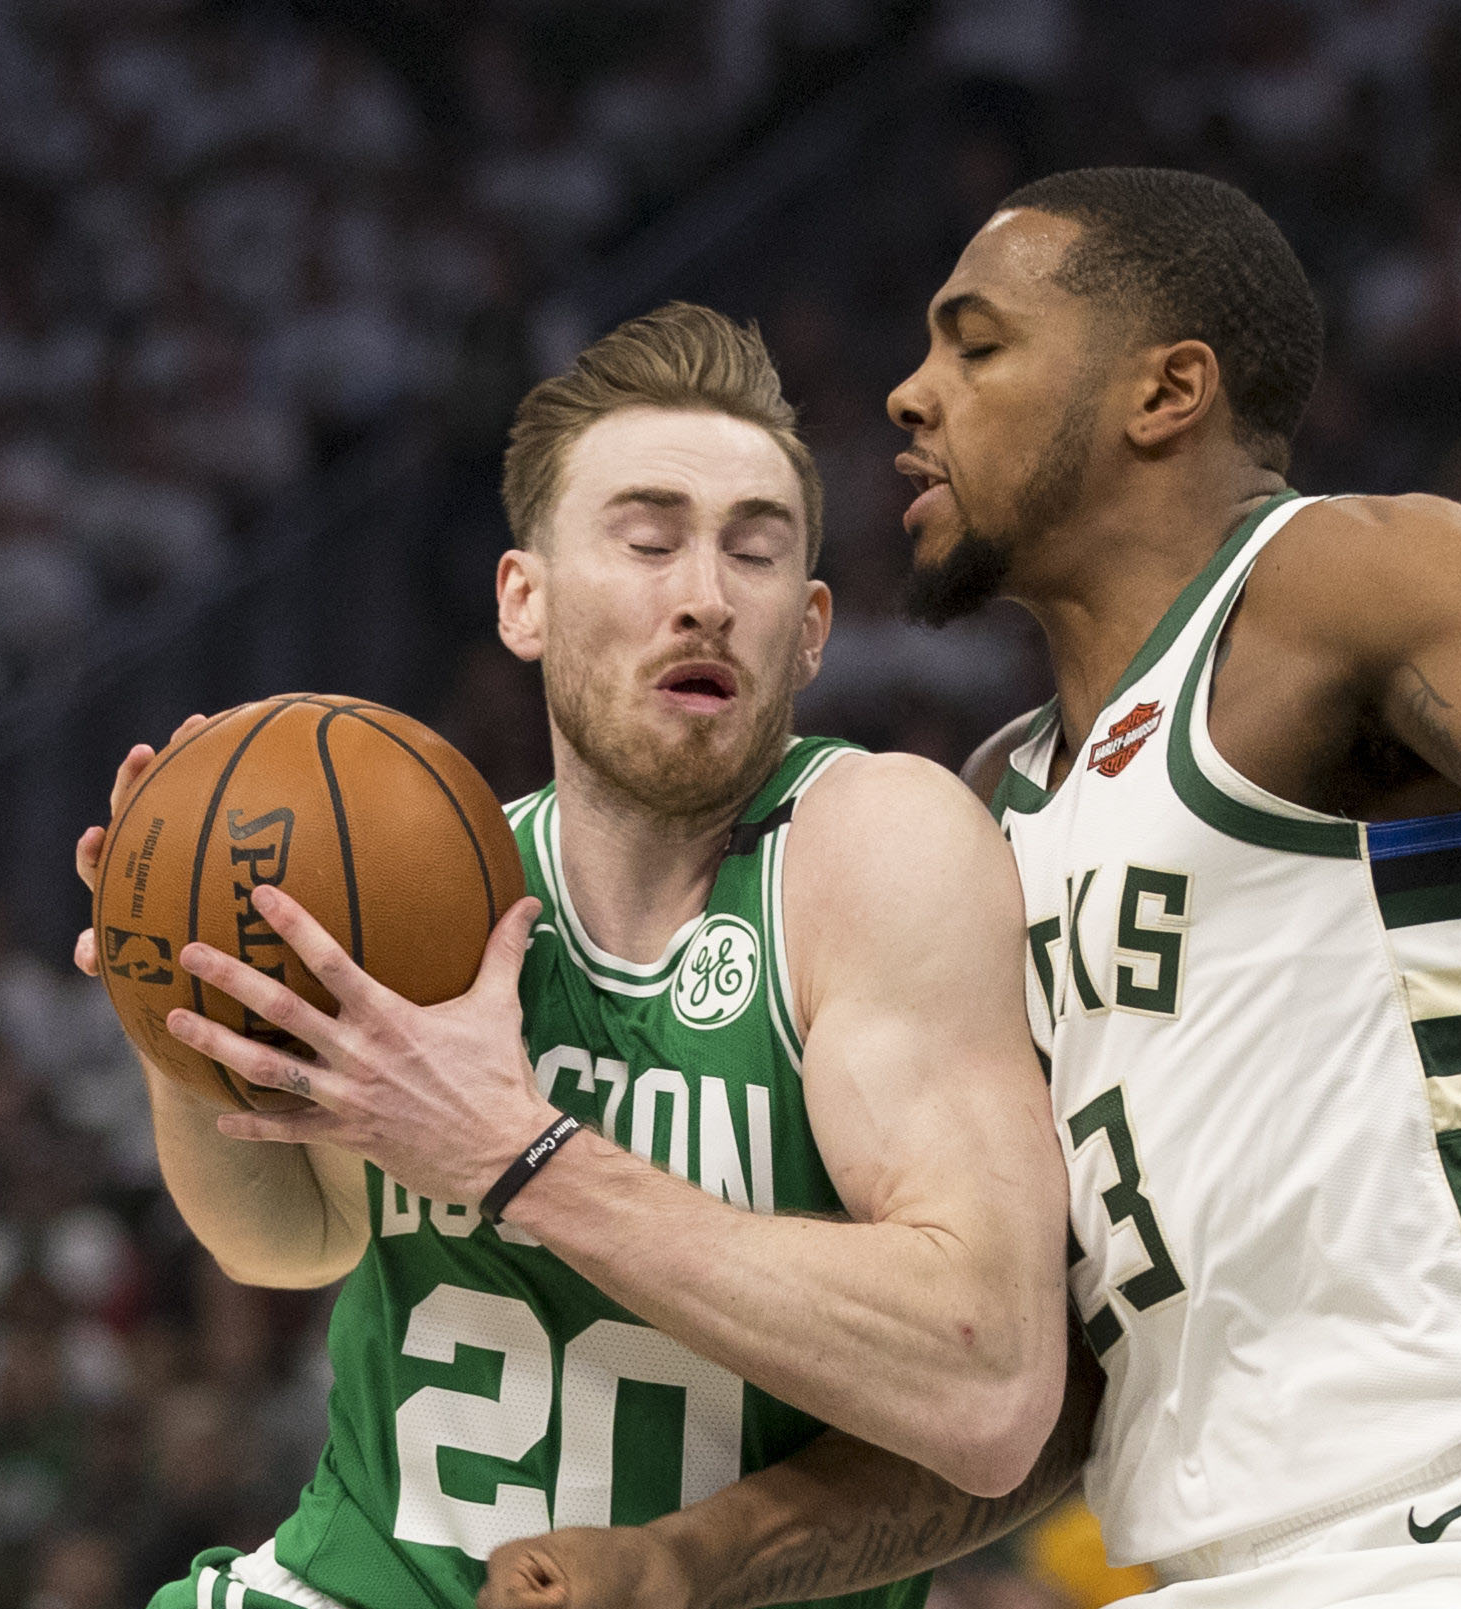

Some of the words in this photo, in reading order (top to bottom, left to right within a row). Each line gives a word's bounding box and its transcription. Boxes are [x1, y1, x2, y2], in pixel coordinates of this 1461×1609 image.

[140, 817, 165, 861] OFFICIAL
[689, 937, 744, 1007] GE
[524, 1136, 557, 1169] Coepi
[552, 1116, 580, 1139] Nunc
[1066, 1079, 1190, 1348] 3
[393, 1282, 745, 1562] 20
